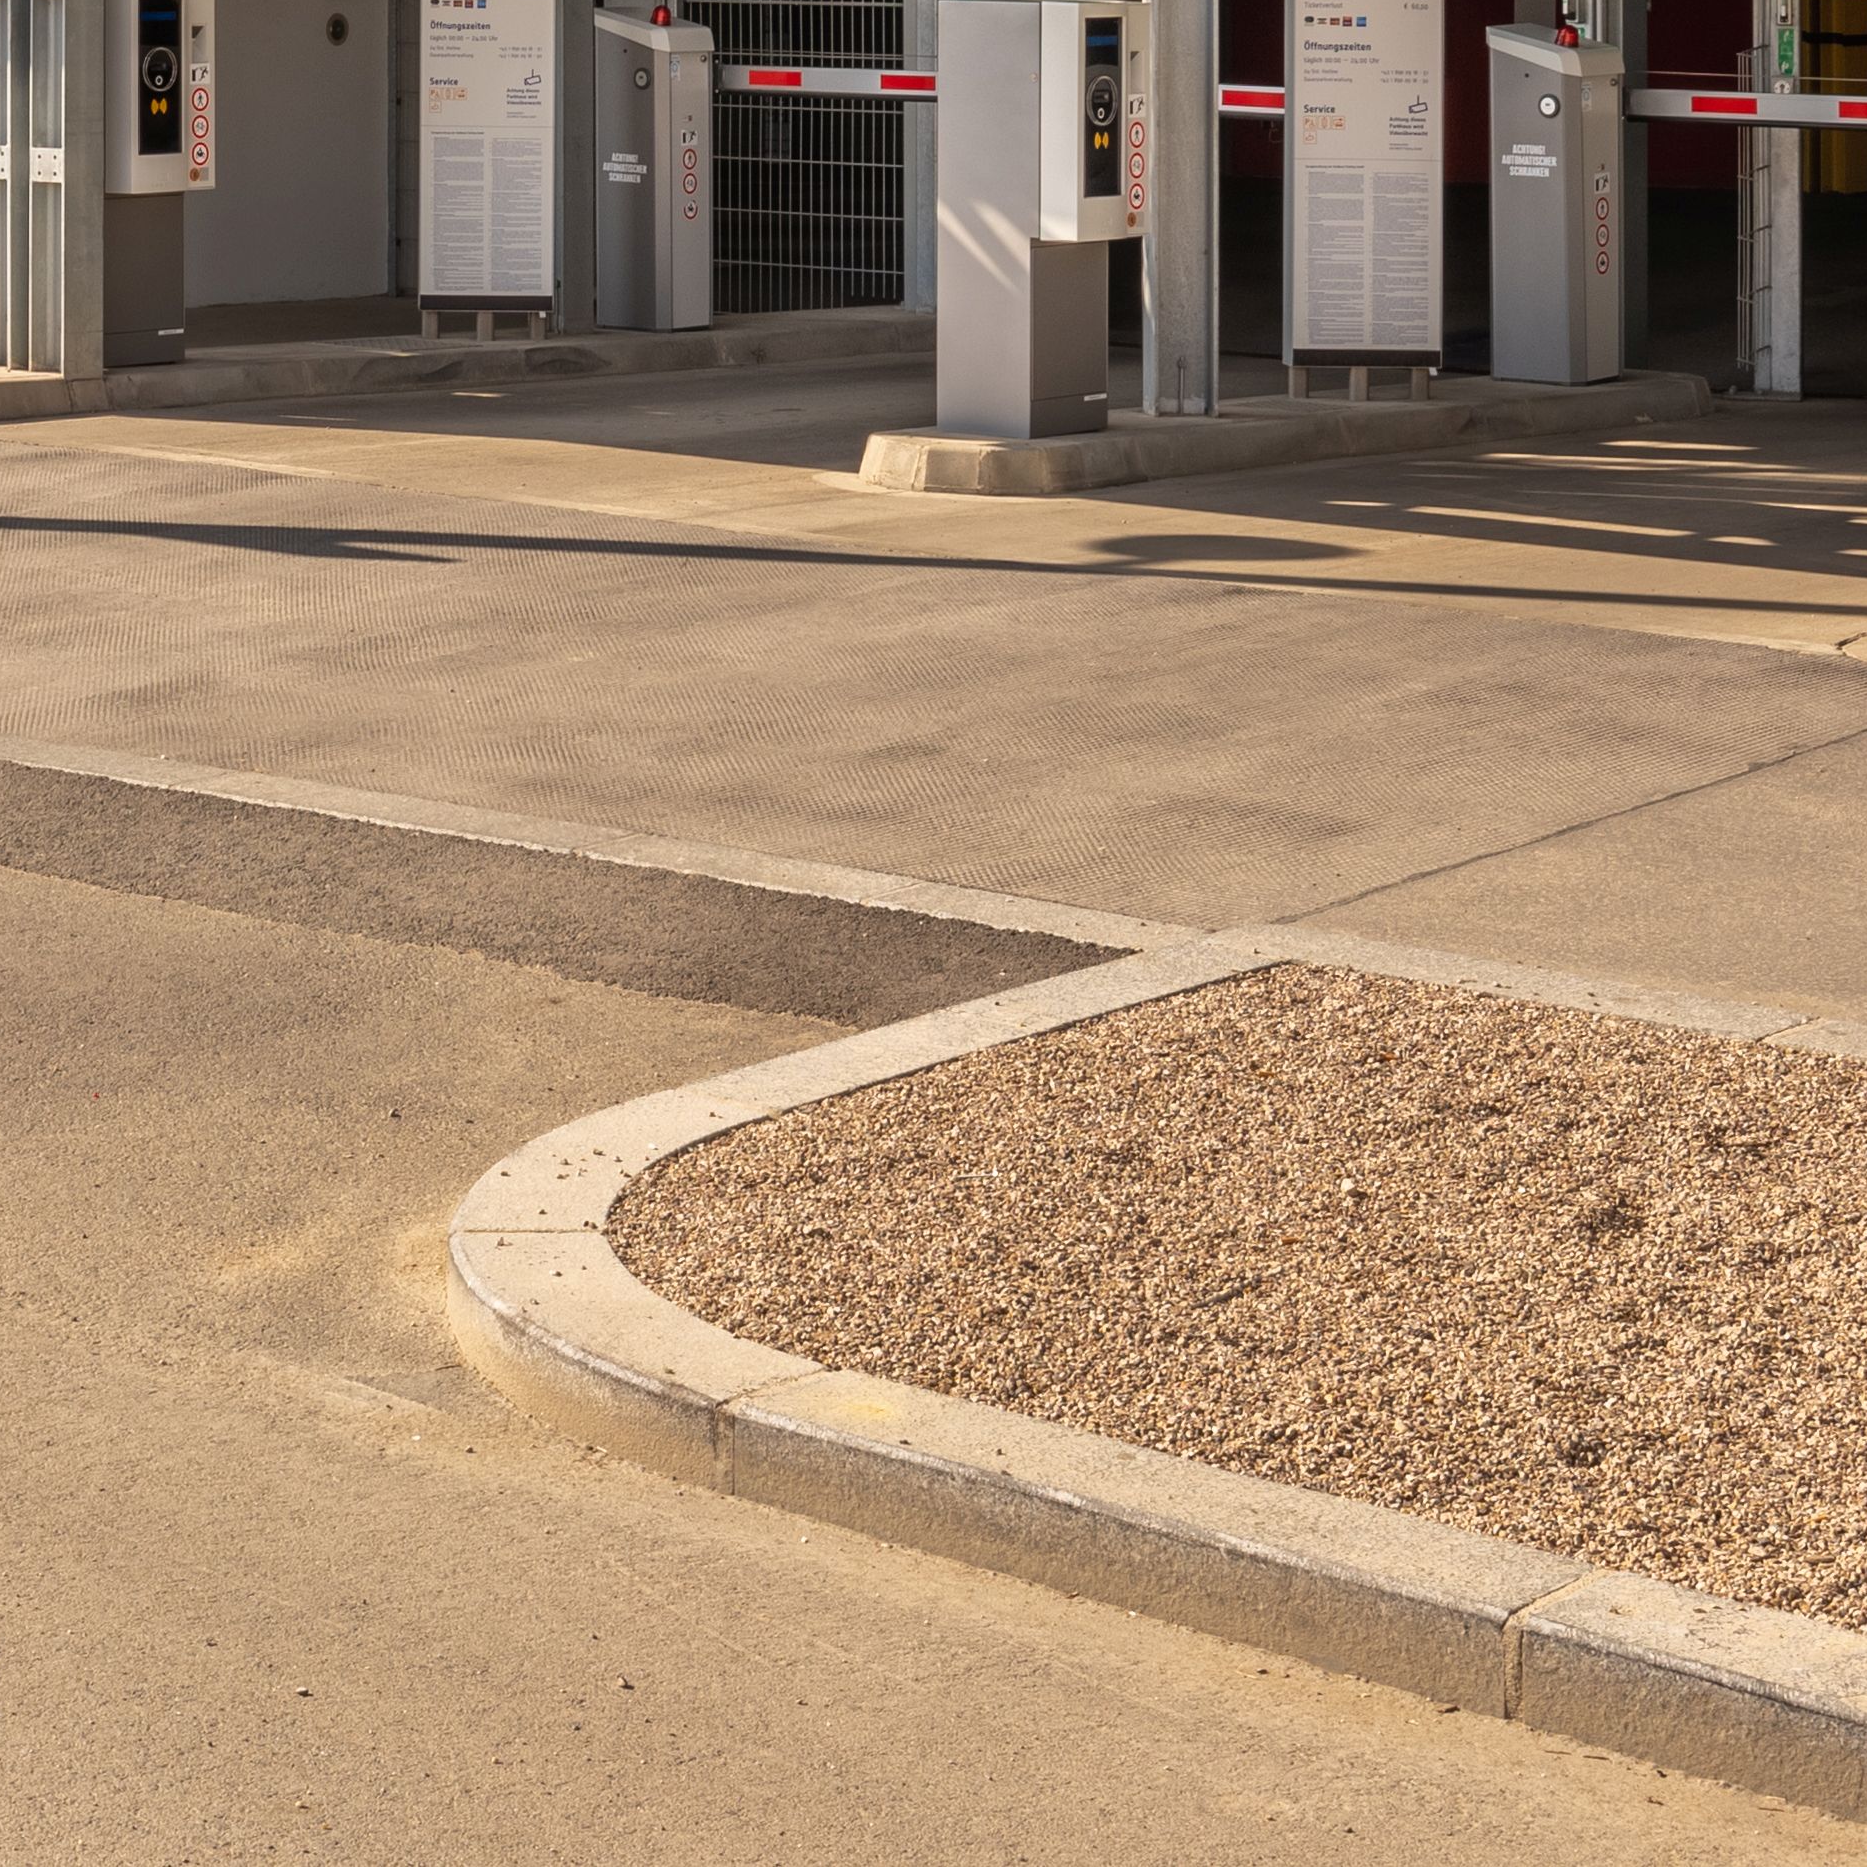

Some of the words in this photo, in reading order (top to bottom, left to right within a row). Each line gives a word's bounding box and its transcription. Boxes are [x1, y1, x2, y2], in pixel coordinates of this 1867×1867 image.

[430, 21, 491, 31] Öffnungszeiten
[1304, 40, 1371, 51] Öffnungszeiten
[430, 77, 458, 86] Service
[1304, 104, 1335, 114] Service
[1501, 154, 1557, 166] AUTOMATISCHER
[1509, 166, 1550, 177] SCHRANKEN
